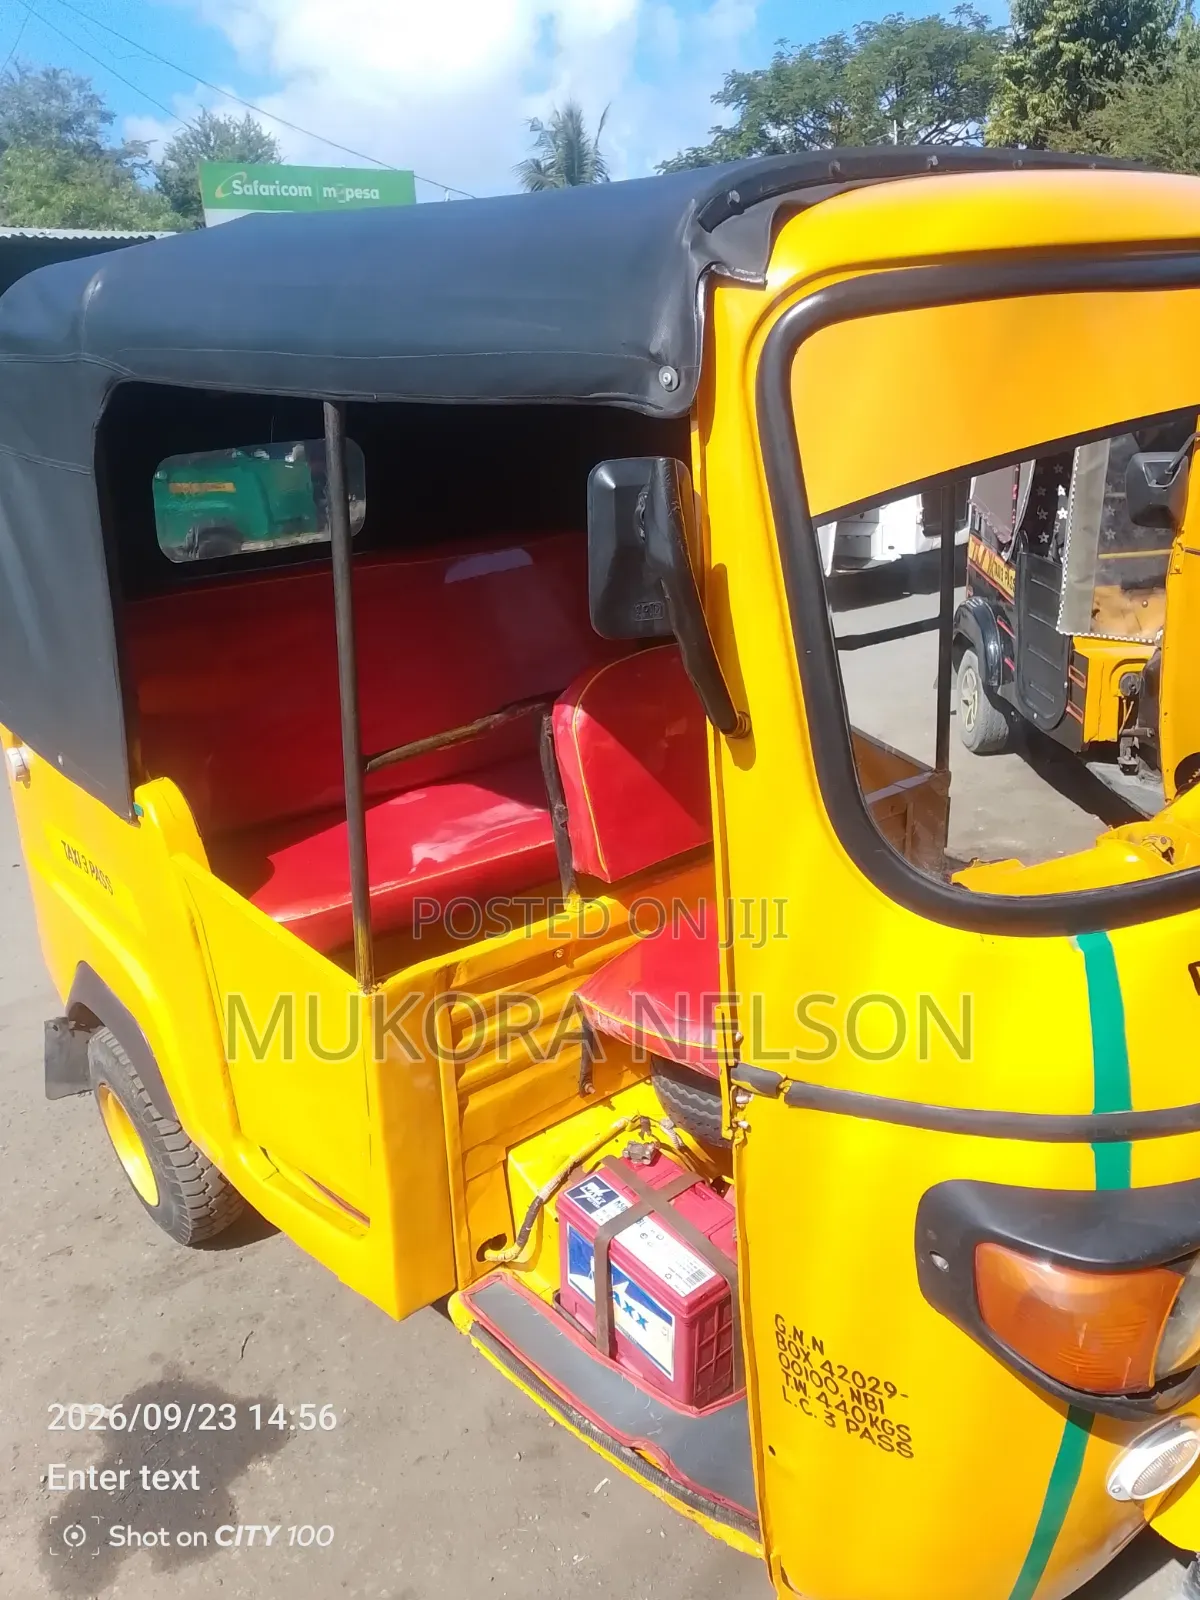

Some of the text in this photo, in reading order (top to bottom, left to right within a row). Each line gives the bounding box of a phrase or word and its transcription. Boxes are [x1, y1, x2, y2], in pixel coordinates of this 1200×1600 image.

[232, 179, 312, 198] Safaricom
[61, 840, 114, 896] TAXI 3 PASS
[776, 1331, 813, 1368] BOX
[824, 1410, 836, 1428] 3
[845, 1418, 914, 1459] PASS
